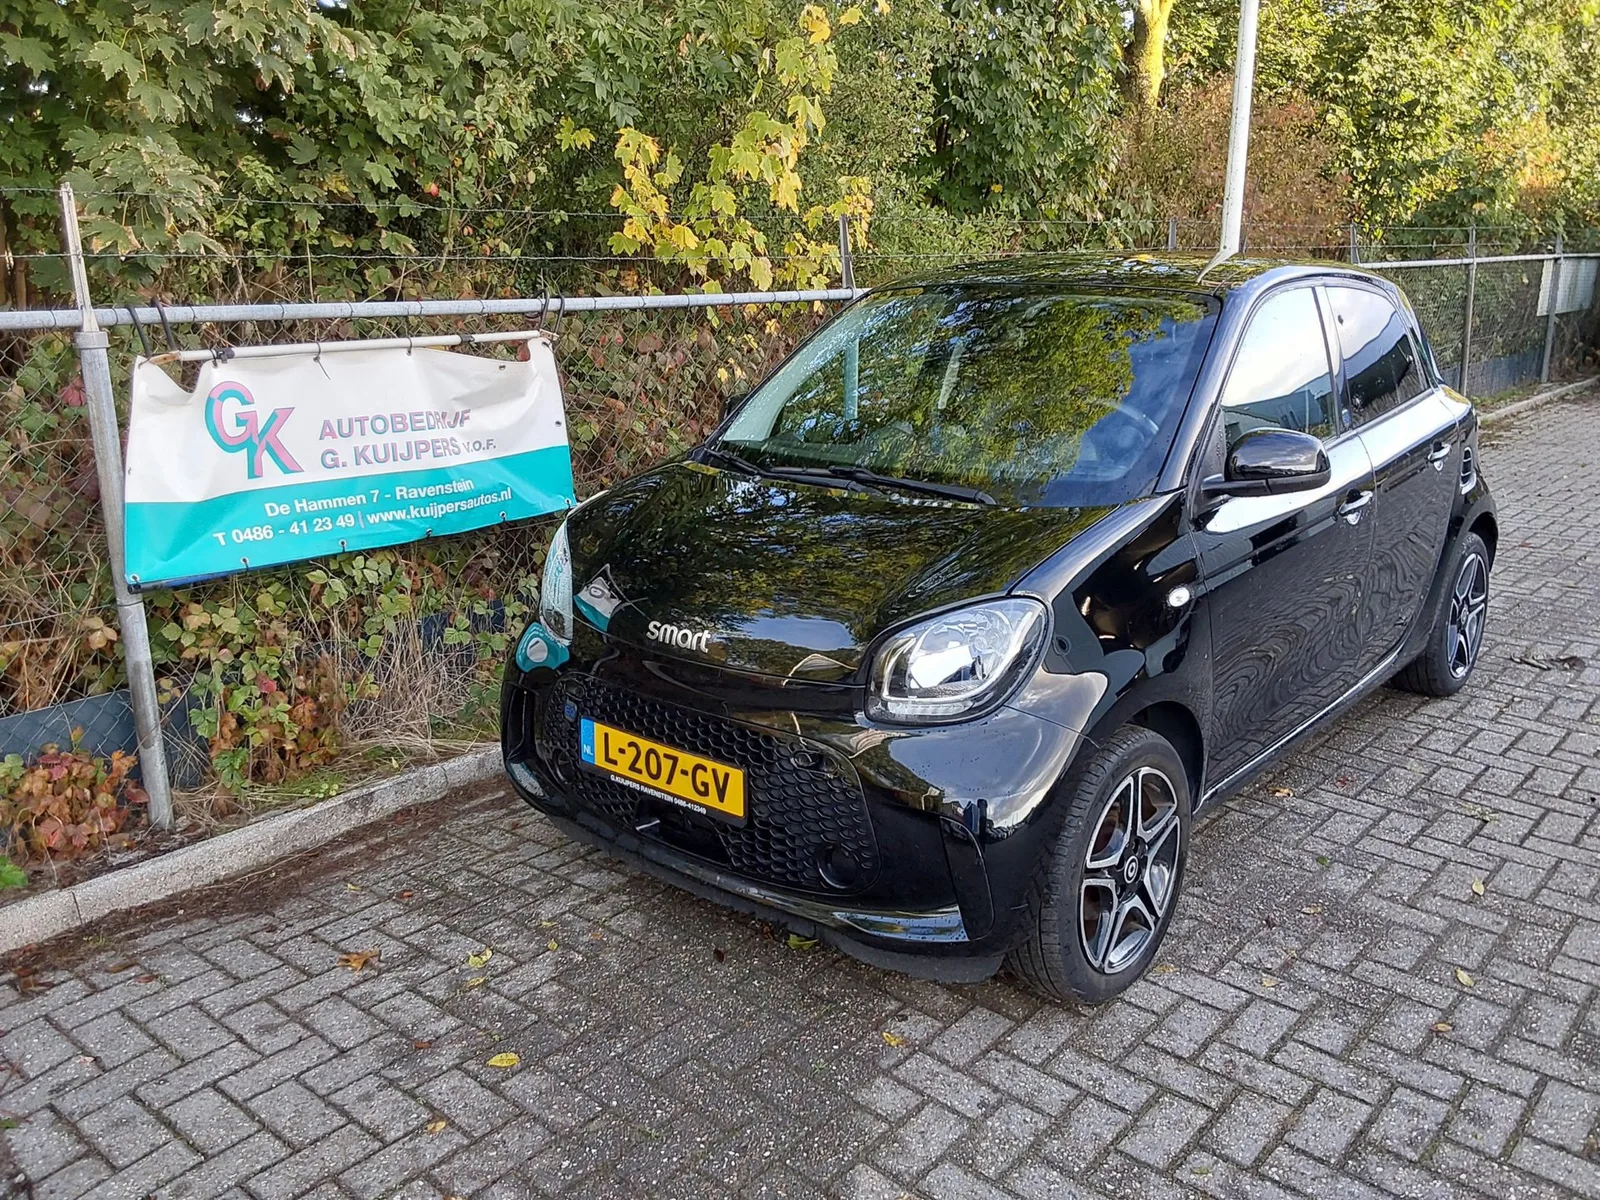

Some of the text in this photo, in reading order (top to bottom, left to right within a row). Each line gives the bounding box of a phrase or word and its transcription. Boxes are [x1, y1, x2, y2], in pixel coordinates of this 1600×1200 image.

[319, 408, 471, 440] AUTOBEDRIJF
[321, 448, 347, 469] G.
[354, 437, 461, 466] KUIJPERS
[264, 502, 291, 517] De
[294, 494, 367, 513] Hammen
[370, 489, 380, 503] 7
[395, 478, 475, 501] Ravenstein
[212, 531, 227, 546] T
[231, 524, 274, 544] 0486
[289, 520, 308, 535] 41
[312, 516, 333, 532] 23
[335, 513, 355, 528] 49
[367, 486, 512, 524] www.kuijpersautos.nl
[646, 620, 712, 654] smart
[583, 743, 594, 756] NL
[603, 731, 731, 804] L-207-GV
[640, 785, 674, 805] RAVENSTEIN
